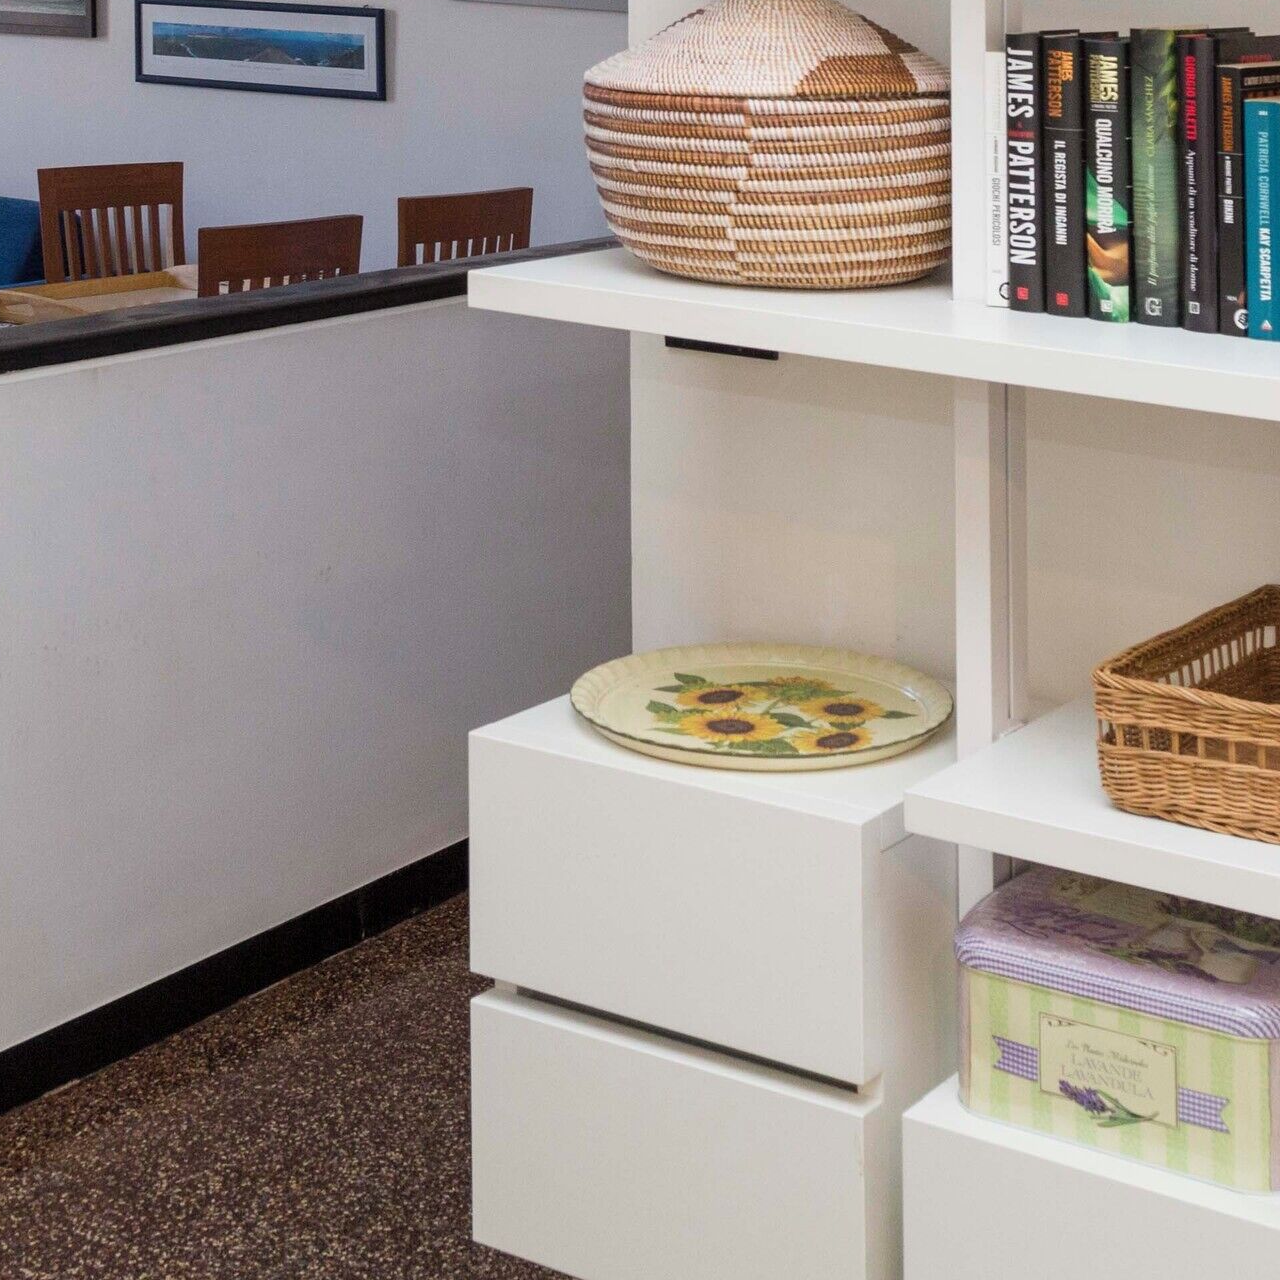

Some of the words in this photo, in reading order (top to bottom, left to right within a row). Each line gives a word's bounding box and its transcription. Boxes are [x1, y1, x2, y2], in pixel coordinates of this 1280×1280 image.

[1007, 47, 1034, 118] JAMES
[1047, 50, 1062, 118] PATTERSON
[1061, 51, 1073, 81] JAMES
[1099, 54, 1118, 101] JAMES
[1185, 56, 1197, 98] GIORGIO
[1054, 140, 1065, 150] IL
[1094, 118, 1113, 183] QUALCUNO
[1258, 131, 1269, 174] PATRICIA
[1054, 152, 1066, 190] REGISTA
[1185, 149, 1197, 186] Appunti
[1007, 140, 1036, 265] PATTERSON
[1055, 193, 1066, 203] DI
[1097, 186, 1116, 233] MORIRÀ
[1188, 188, 1197, 196] di
[1188, 198, 1195, 209] un
[1258, 176, 1270, 225] CORNWELL
[1055, 205, 1067, 245] INGANNI
[1188, 211, 1197, 251] venditore
[1259, 228, 1270, 246] KAY
[1189, 253, 1198, 261] di
[1189, 262, 1198, 292] donne
[1259, 248, 1271, 301] SCARPETTA
